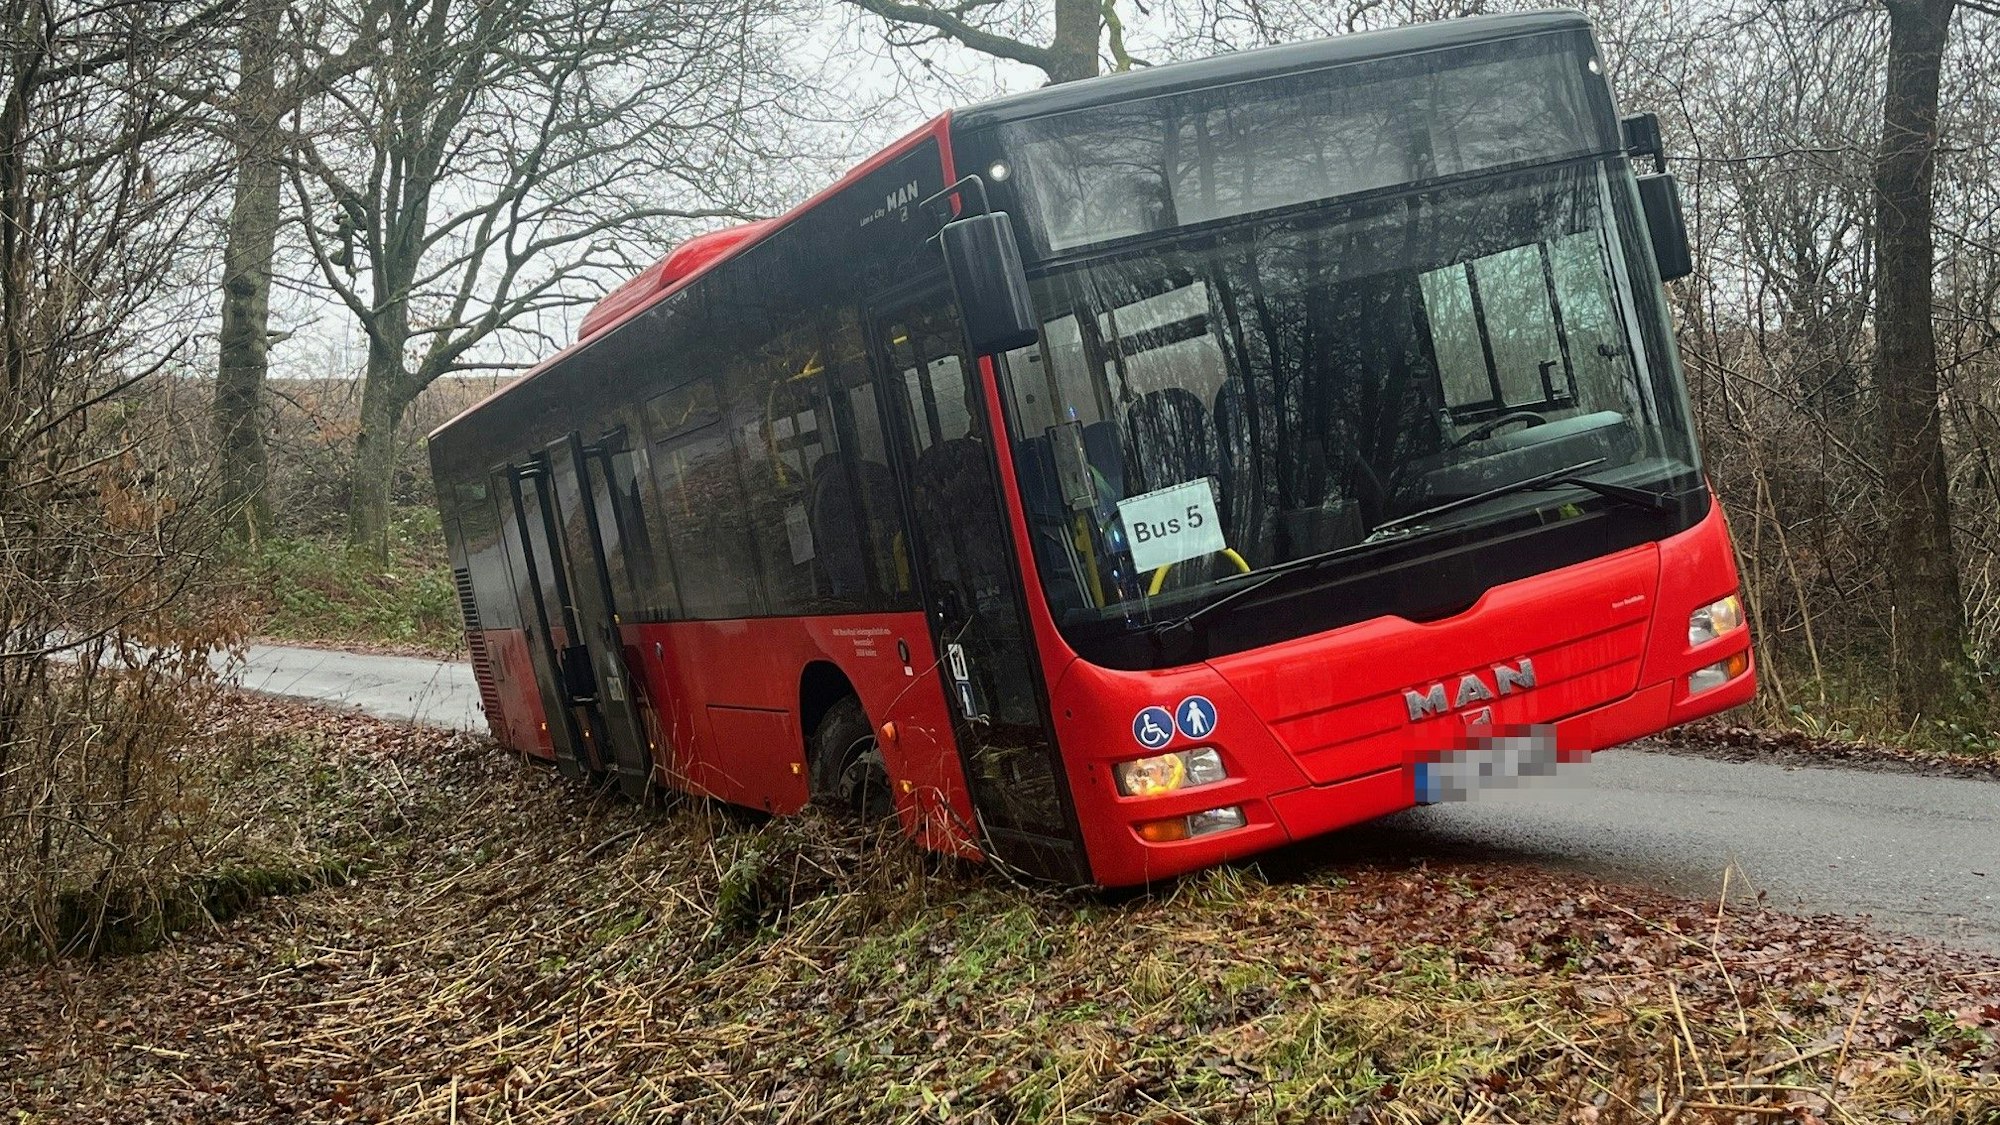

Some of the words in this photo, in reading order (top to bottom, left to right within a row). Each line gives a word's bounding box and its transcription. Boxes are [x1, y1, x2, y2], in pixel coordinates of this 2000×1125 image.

[886, 180, 919, 212] MAN
[1133, 519, 1181, 543] Bus
[1186, 504, 1203, 528] 5
[1404, 657, 1537, 721] MAN
